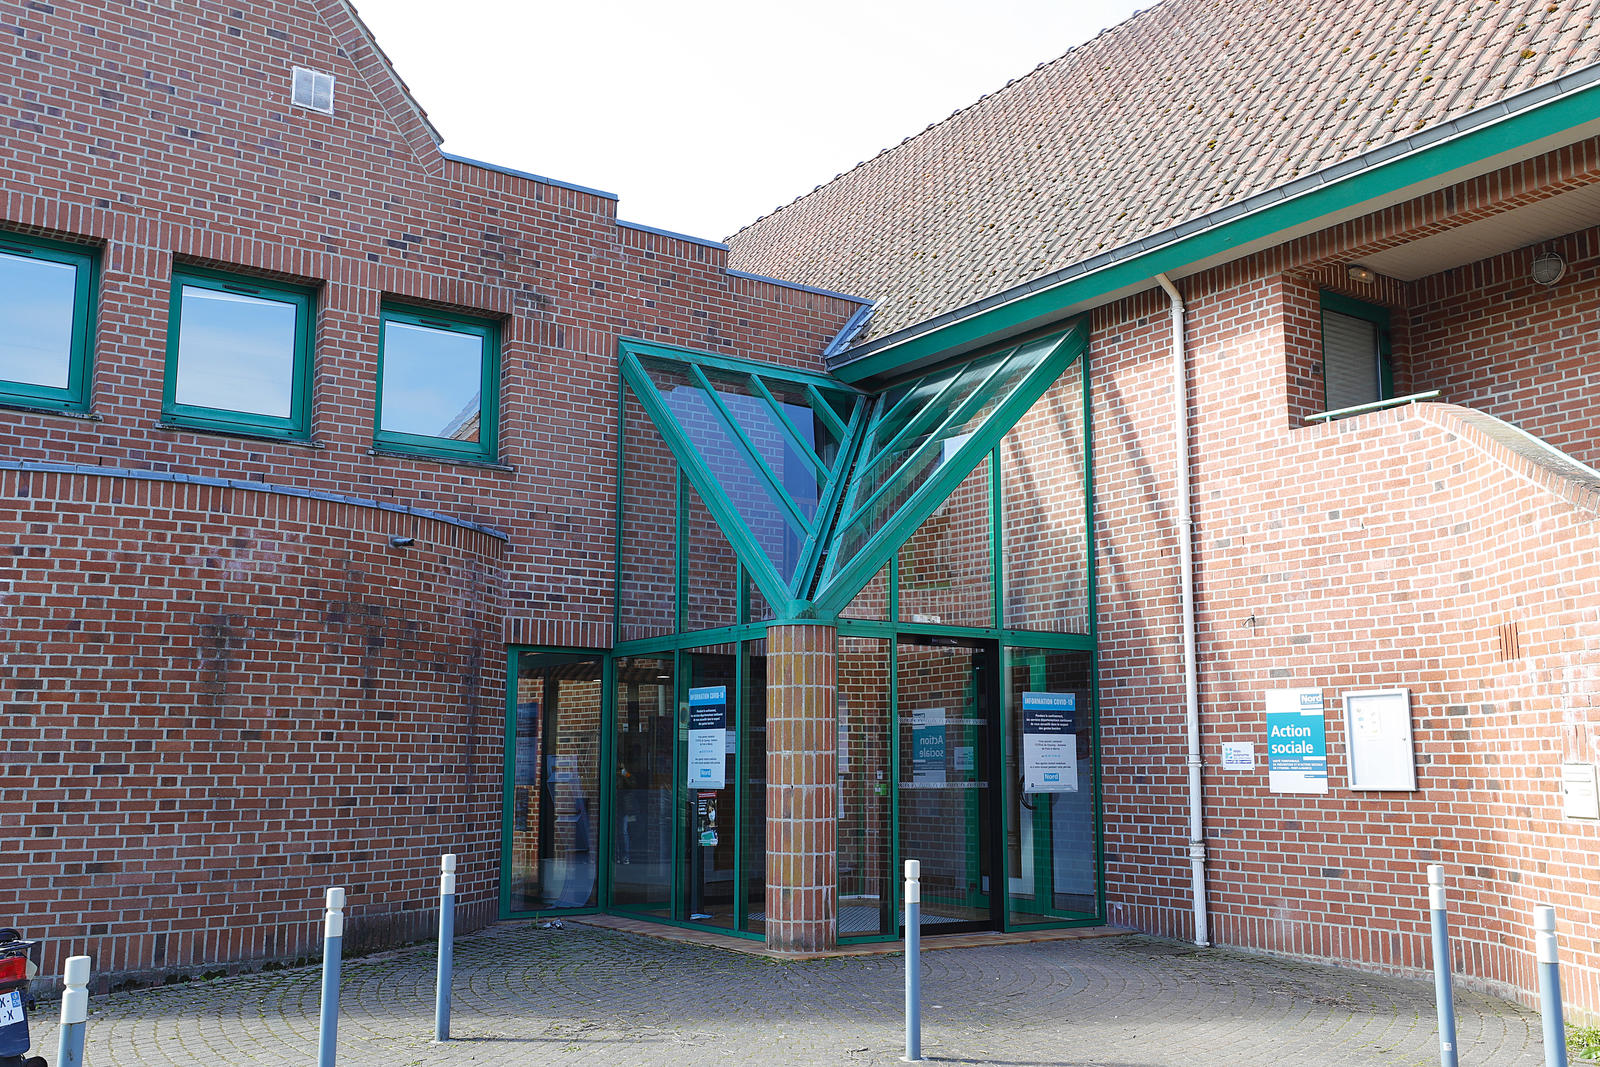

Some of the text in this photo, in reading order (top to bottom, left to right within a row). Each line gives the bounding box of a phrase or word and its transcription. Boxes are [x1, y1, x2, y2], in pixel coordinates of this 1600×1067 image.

[1302, 694, 1322, 703] Nord
[1271, 724, 1310, 737] Action
[1272, 740, 1313, 753] sociale
